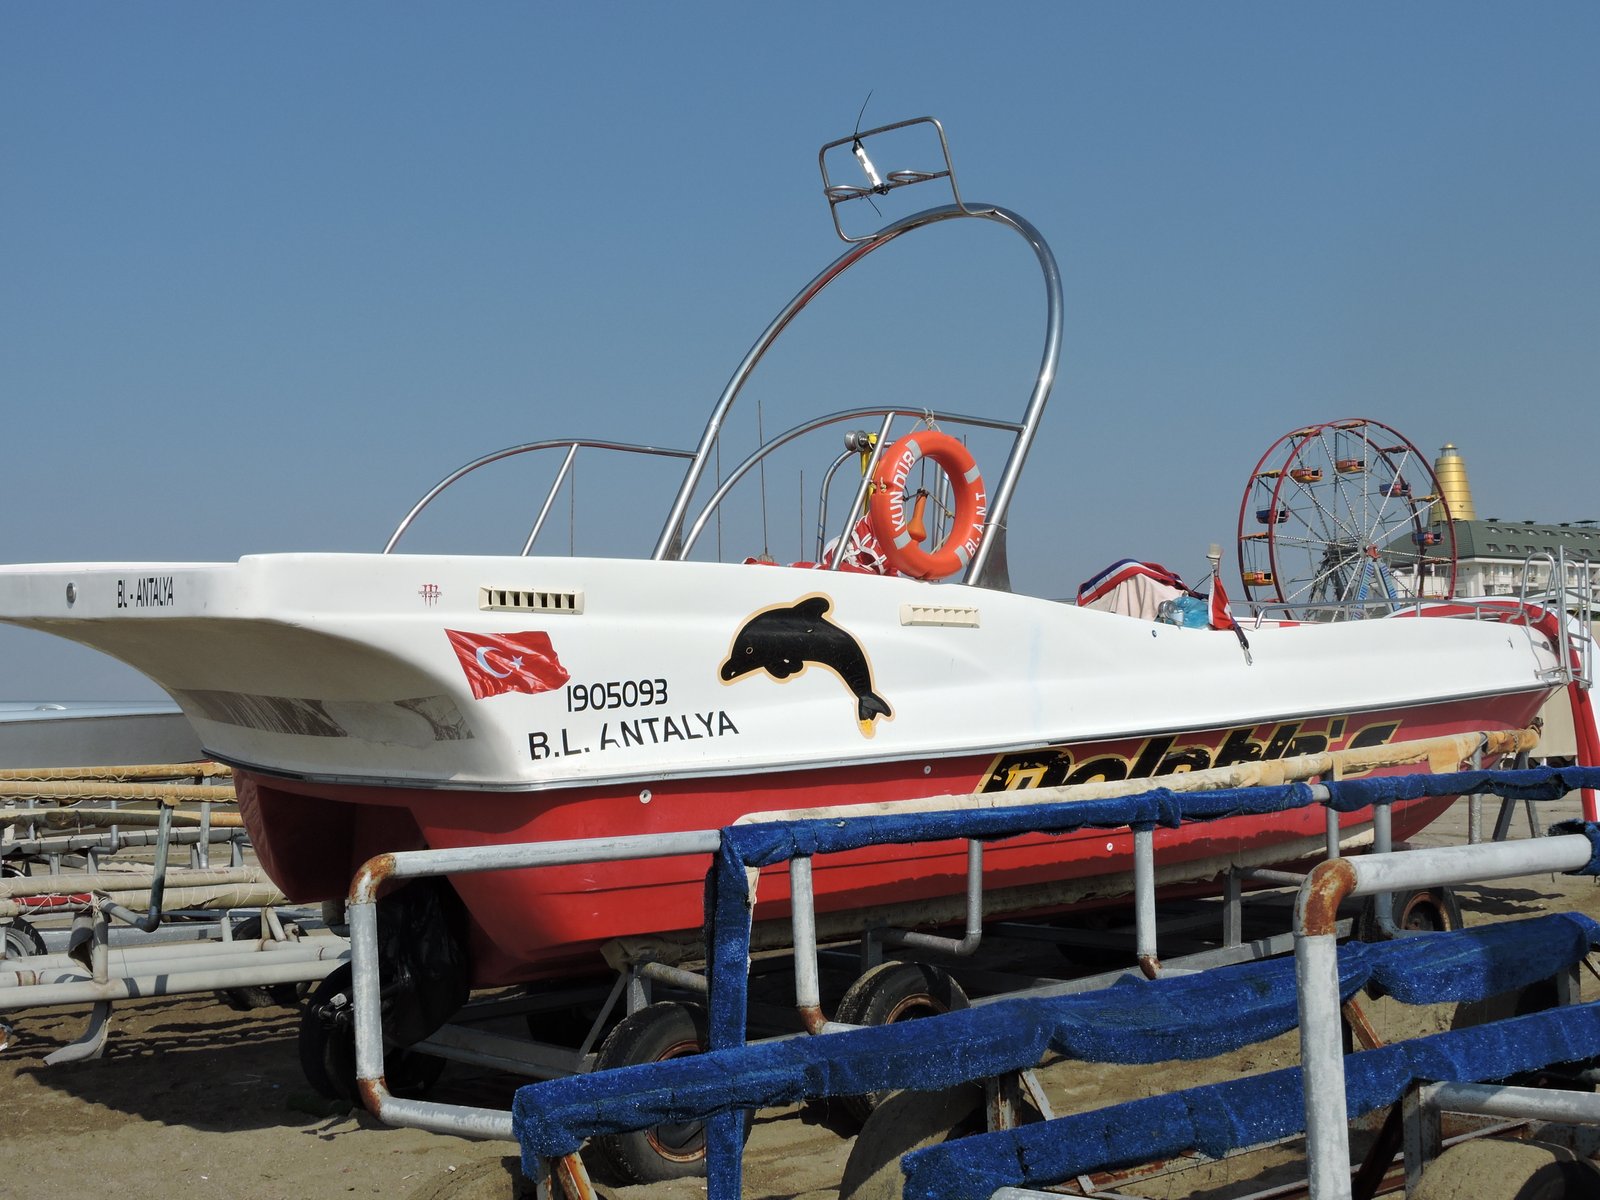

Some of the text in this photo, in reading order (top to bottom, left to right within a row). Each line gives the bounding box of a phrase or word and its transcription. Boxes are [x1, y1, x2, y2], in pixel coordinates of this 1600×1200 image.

[135, 576, 174, 607] ANTALYA
[566, 678, 669, 713] 1905093
[600, 710, 740, 751] ANTALYA
